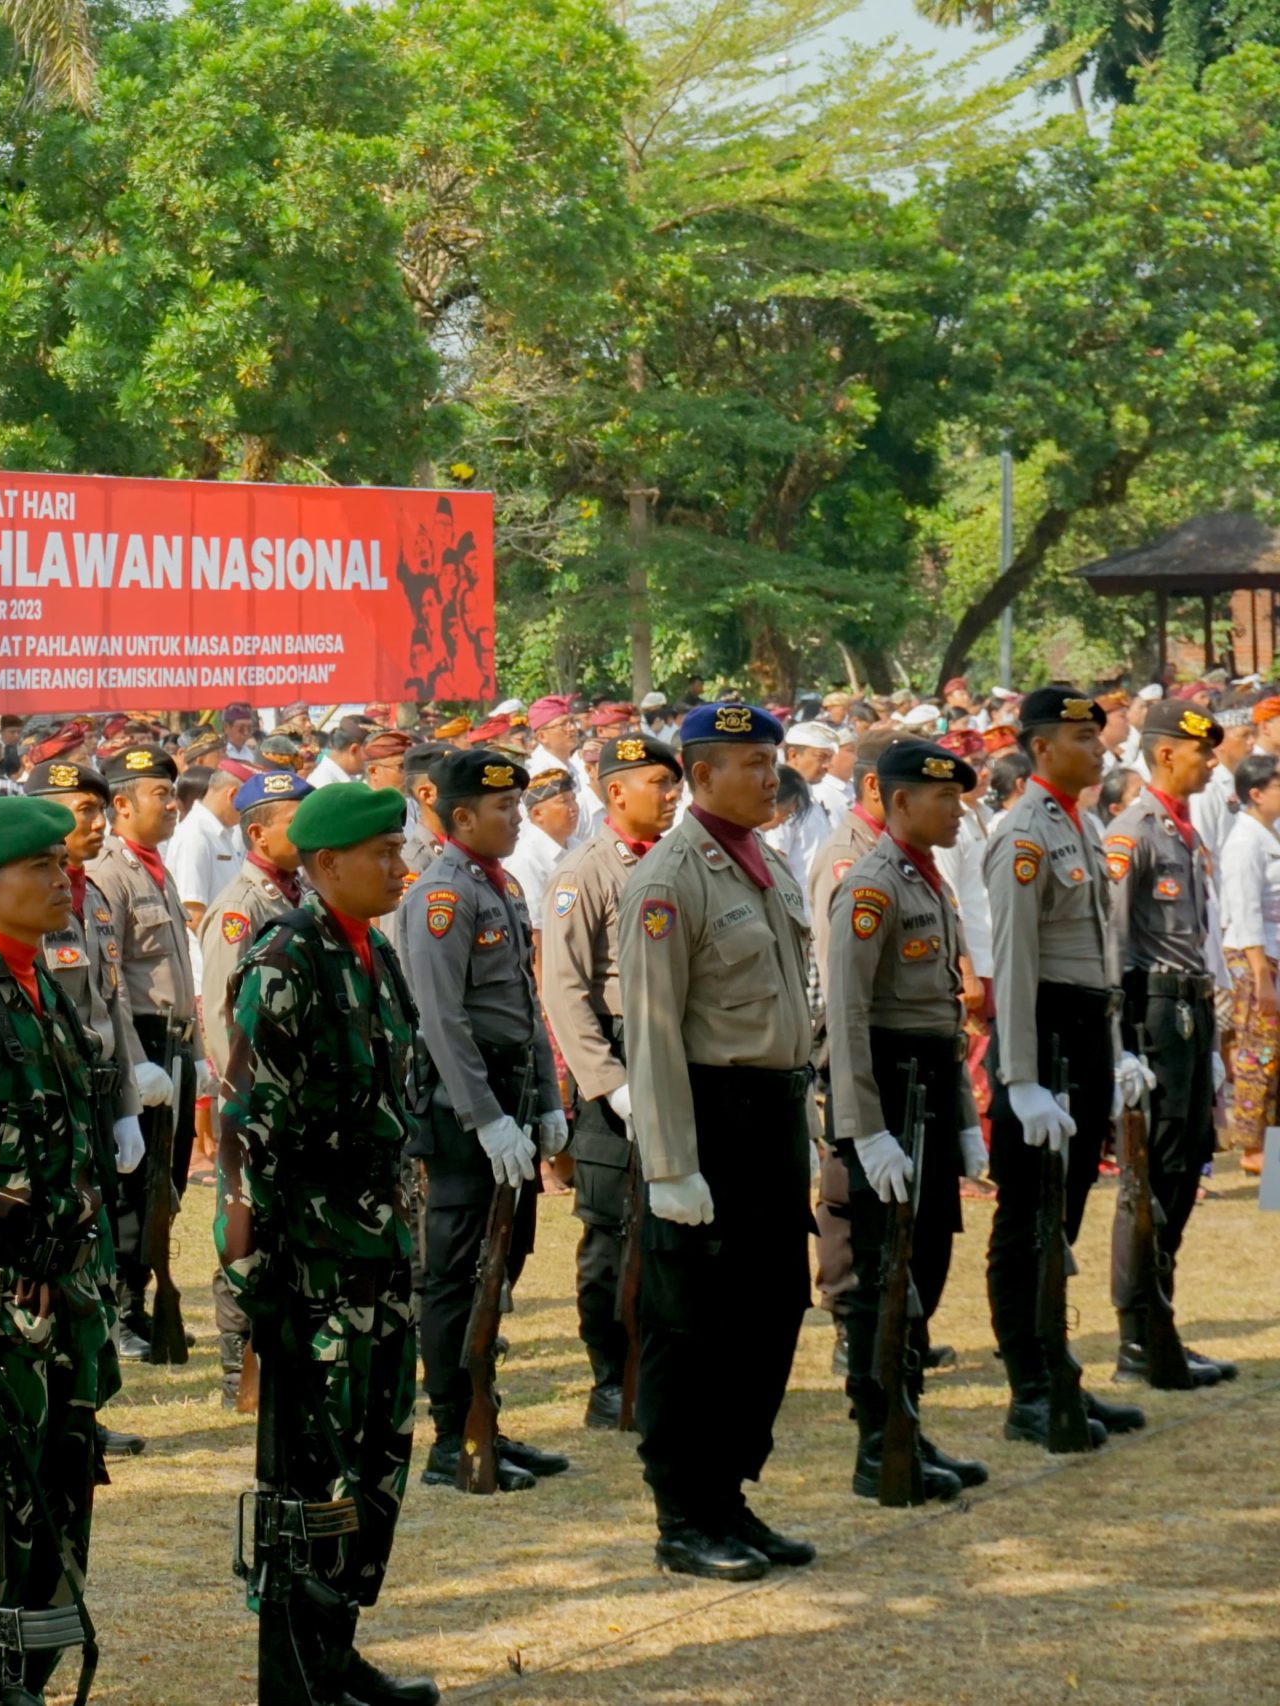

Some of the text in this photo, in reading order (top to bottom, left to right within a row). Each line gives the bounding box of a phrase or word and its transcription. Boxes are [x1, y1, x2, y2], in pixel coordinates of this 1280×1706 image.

[22, 490, 76, 520] HARI
[191, 536, 388, 591] NASIONAL
[10, 599, 42, 620] 2023
[25, 635, 123, 657] PAHLAWAN
[125, 635, 181, 657] UNTUK
[184, 635, 230, 656] MASA
[232, 635, 283, 656] DEPAN
[284, 634, 344, 654] BANGSA
[96, 667, 198, 689] KEMISKINAN
[200, 666, 235, 687] DAN
[237, 664, 336, 686] KEBODOHAN”
